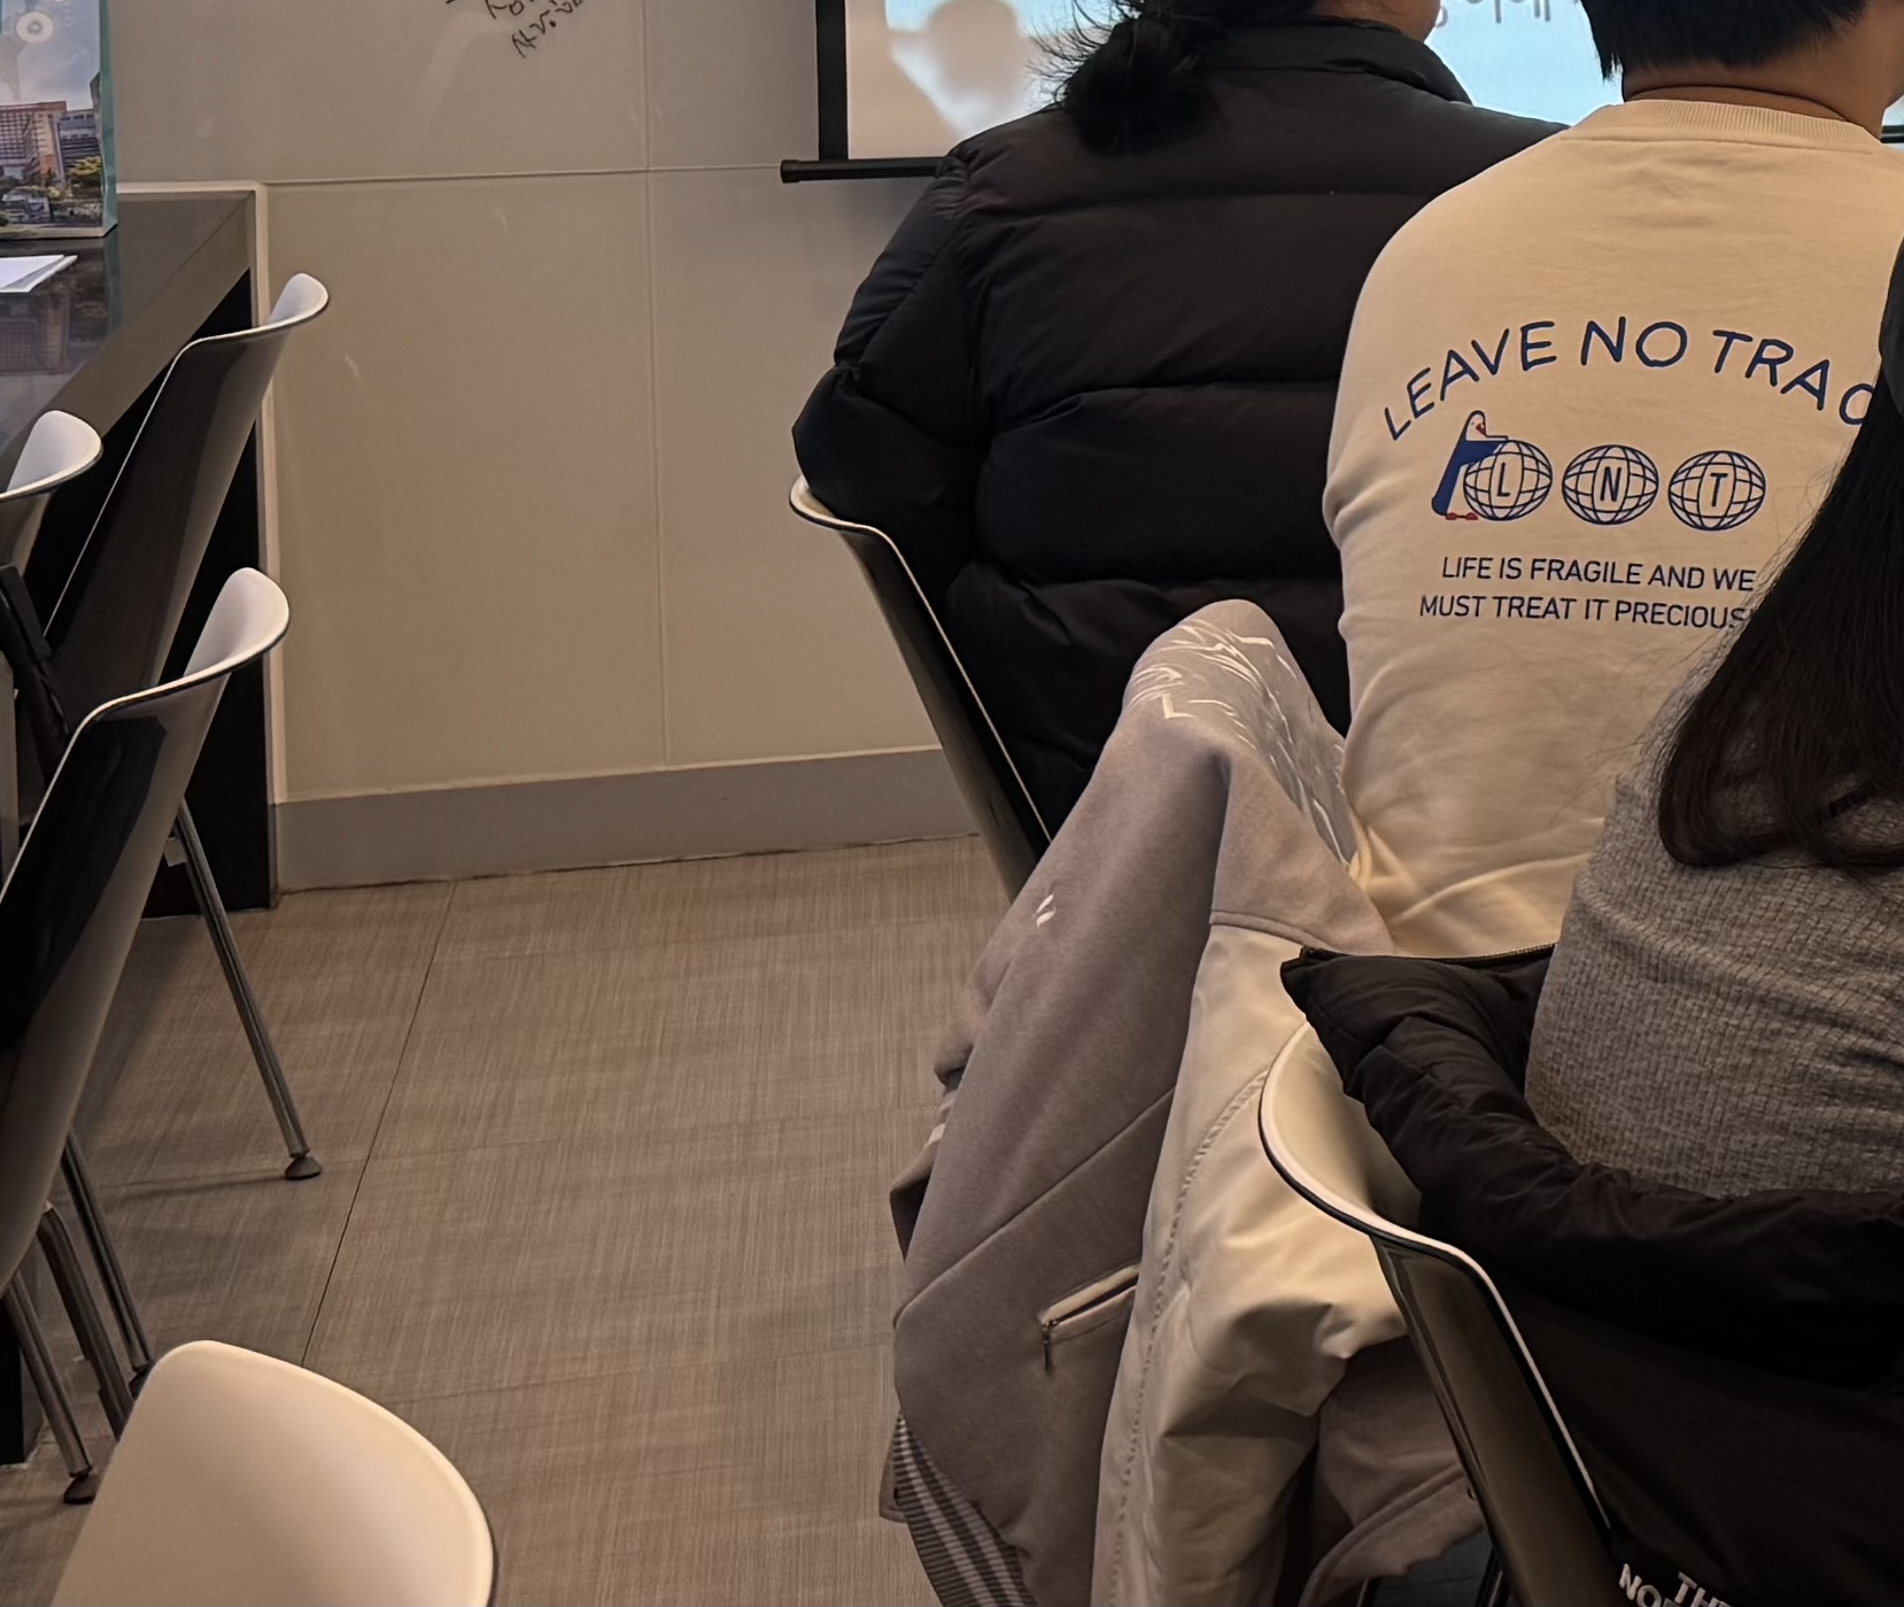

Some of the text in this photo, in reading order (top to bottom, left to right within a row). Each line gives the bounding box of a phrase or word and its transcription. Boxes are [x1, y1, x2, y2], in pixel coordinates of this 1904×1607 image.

[1385, 316, 1874, 440] LEAVE NO TRAC
[1497, 463, 1727, 507] L N T
[1442, 557, 1755, 591] LIFE IS FRAGILE AND WE
[1419, 596, 1483, 618] MUST
[1492, 597, 1570, 619] TREAT
[1585, 598, 1609, 621] IT
